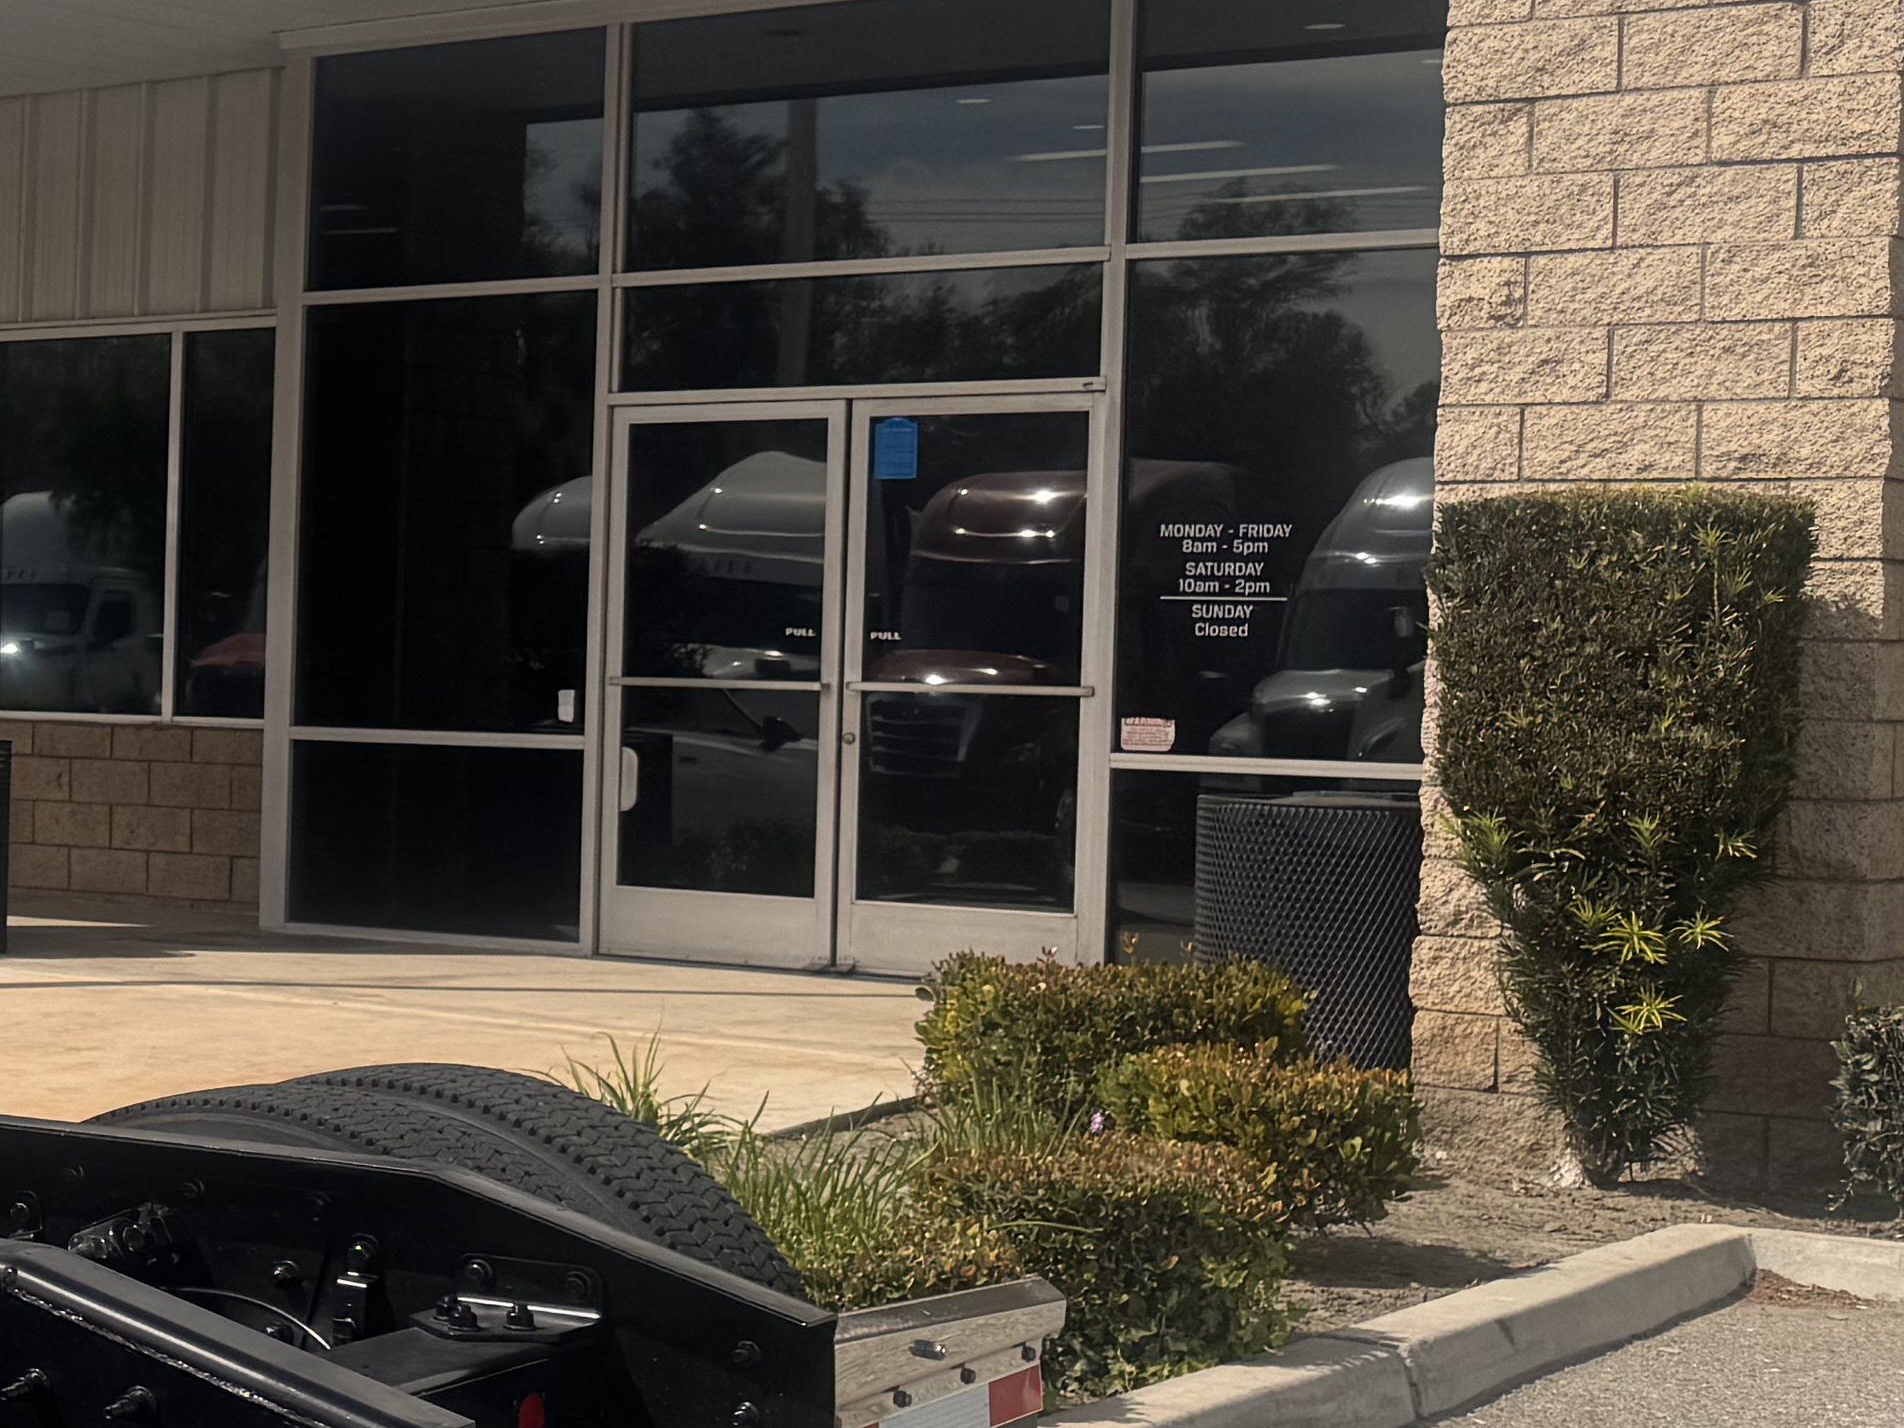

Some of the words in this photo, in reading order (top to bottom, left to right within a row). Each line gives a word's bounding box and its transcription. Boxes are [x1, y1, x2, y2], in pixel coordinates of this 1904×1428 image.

[1160, 524, 1223, 538] MONDAY
[1239, 524, 1292, 538] FRIDAY
[1182, 539, 1217, 553] 8am
[1233, 539, 1268, 556] 5pm
[1185, 562, 1264, 576] SATURDAY
[1179, 578, 1219, 592] 10am
[1235, 579, 1270, 596] 2pm
[1192, 604, 1253, 618] SUNDAY
[785, 627, 816, 637] PULL
[870, 631, 901, 641] PULL
[1195, 623, 1248, 637] Closed
